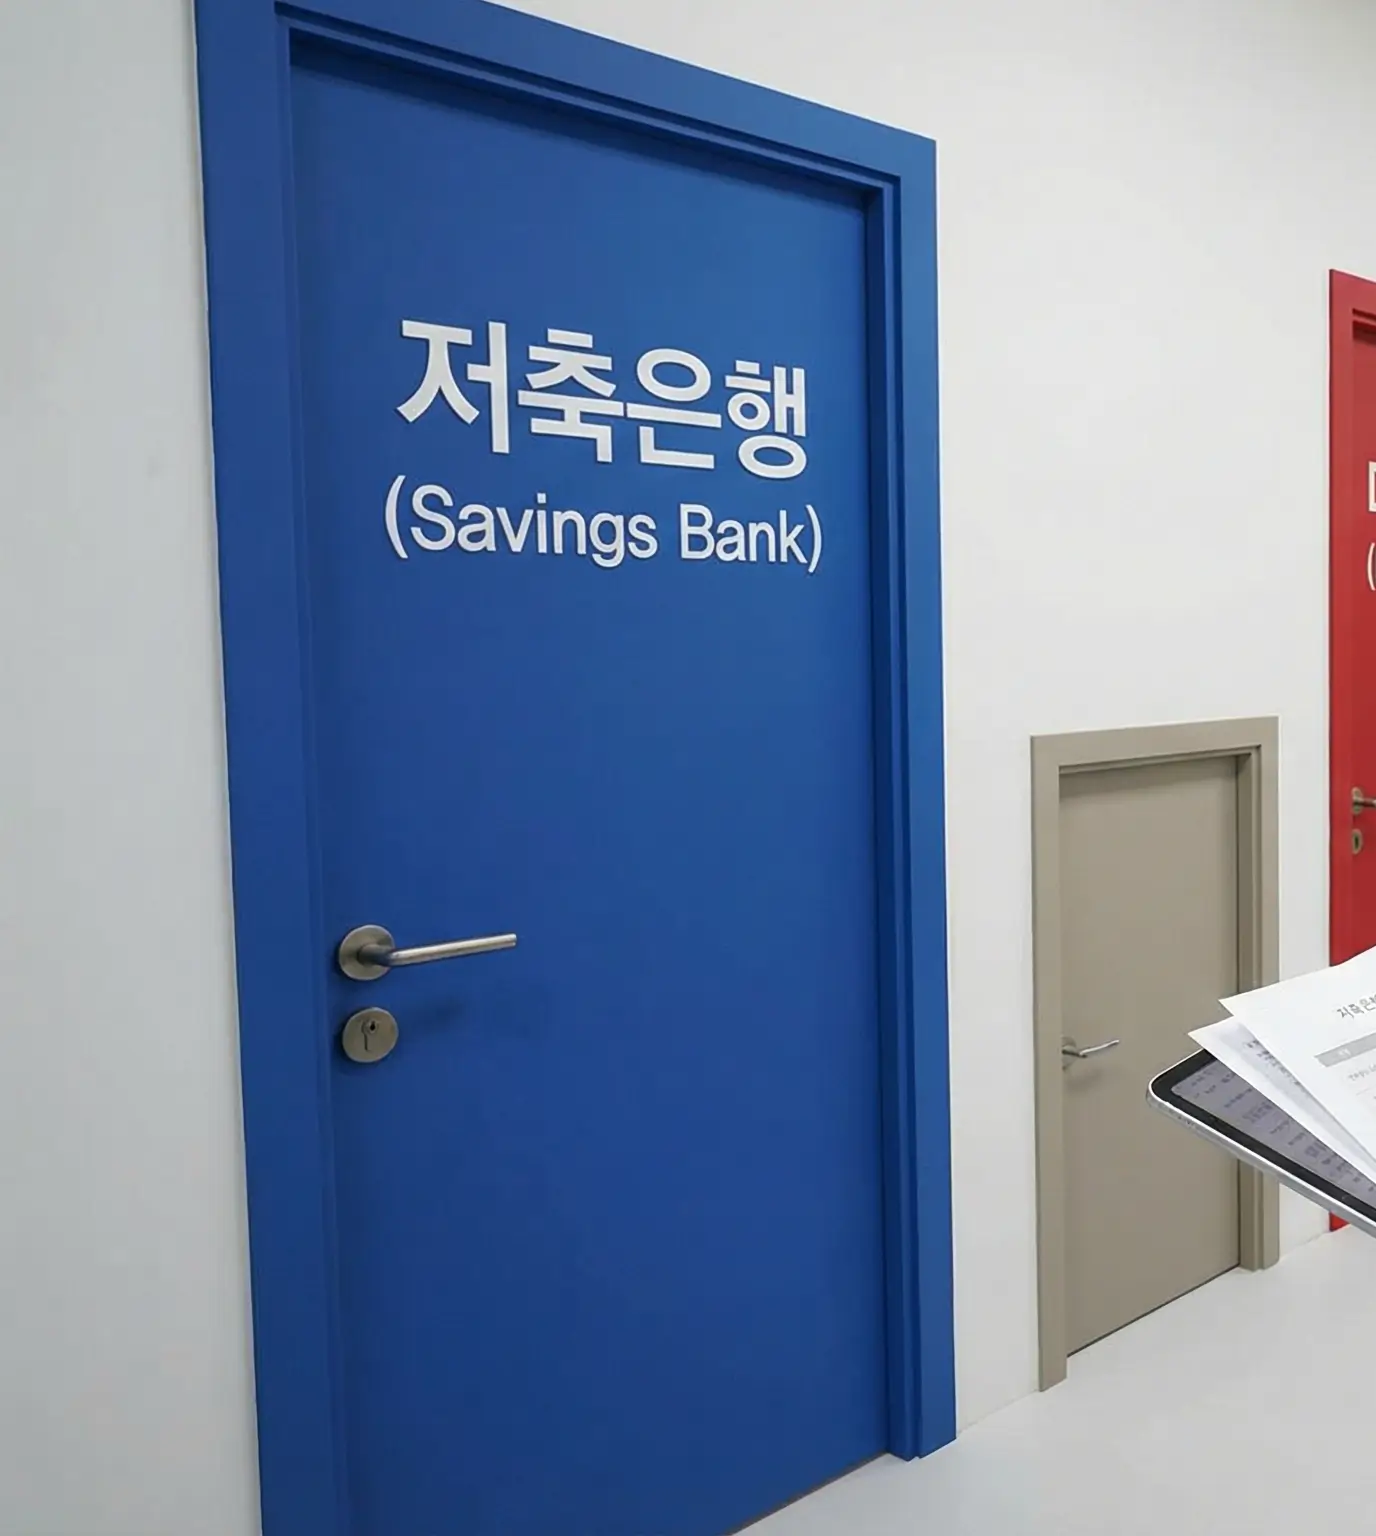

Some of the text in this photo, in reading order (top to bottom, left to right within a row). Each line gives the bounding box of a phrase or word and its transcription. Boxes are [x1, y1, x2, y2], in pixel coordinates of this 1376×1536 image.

[397, 320, 807, 479] 저축은행
[385, 475, 823, 573] (Savings Bank)
